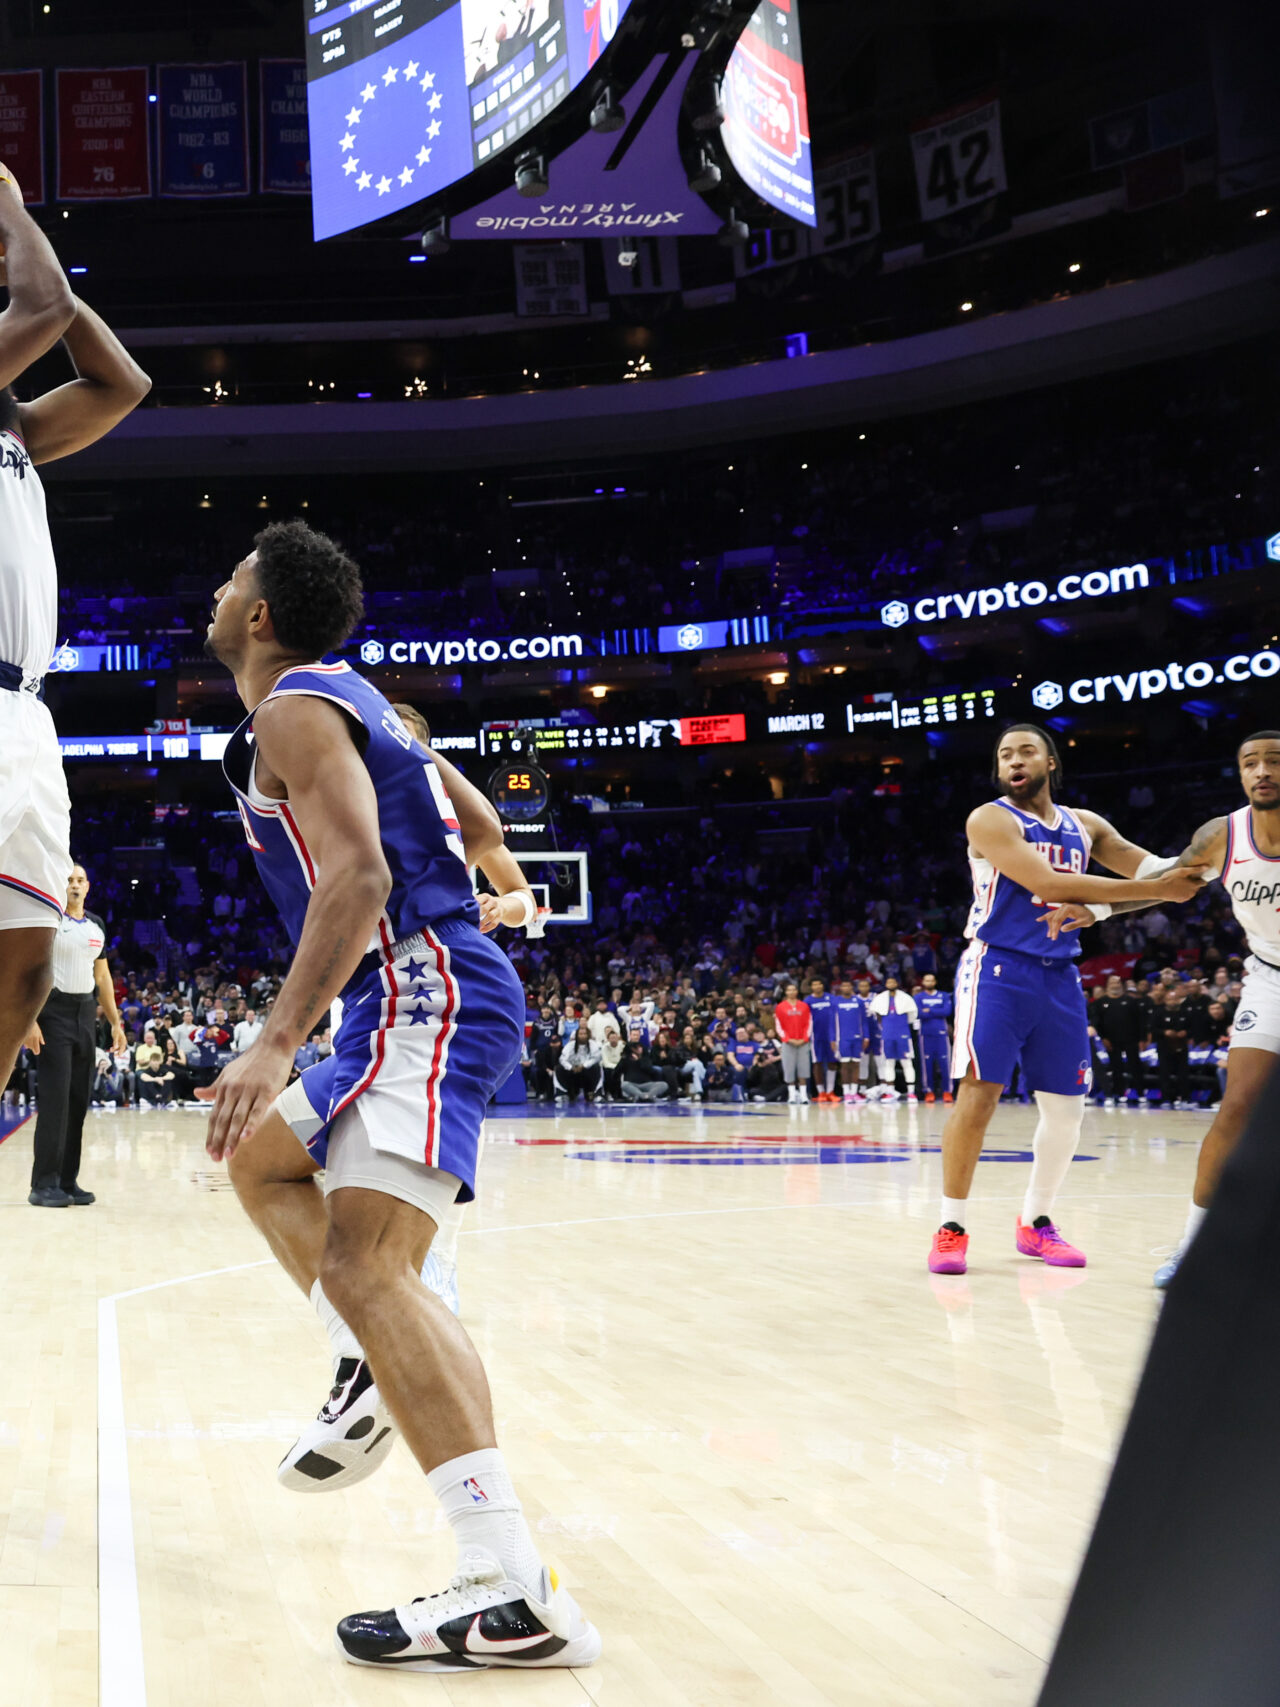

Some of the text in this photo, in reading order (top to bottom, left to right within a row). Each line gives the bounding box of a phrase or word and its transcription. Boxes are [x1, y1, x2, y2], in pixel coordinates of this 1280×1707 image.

[927, 129, 995, 208] 42
[540, 203, 636, 214] ARENA
[821, 175, 871, 246] 35
[476, 211, 684, 230] xfinity mobile
[914, 563, 1149, 621] crypto.com
[389, 634, 583, 666] crypto.com
[583, 728, 591, 737] 4
[768, 713, 825, 733] MARCH 12
[431, 737, 476, 750] CLIPPERS
[510, 824, 545, 833] TISSOT
